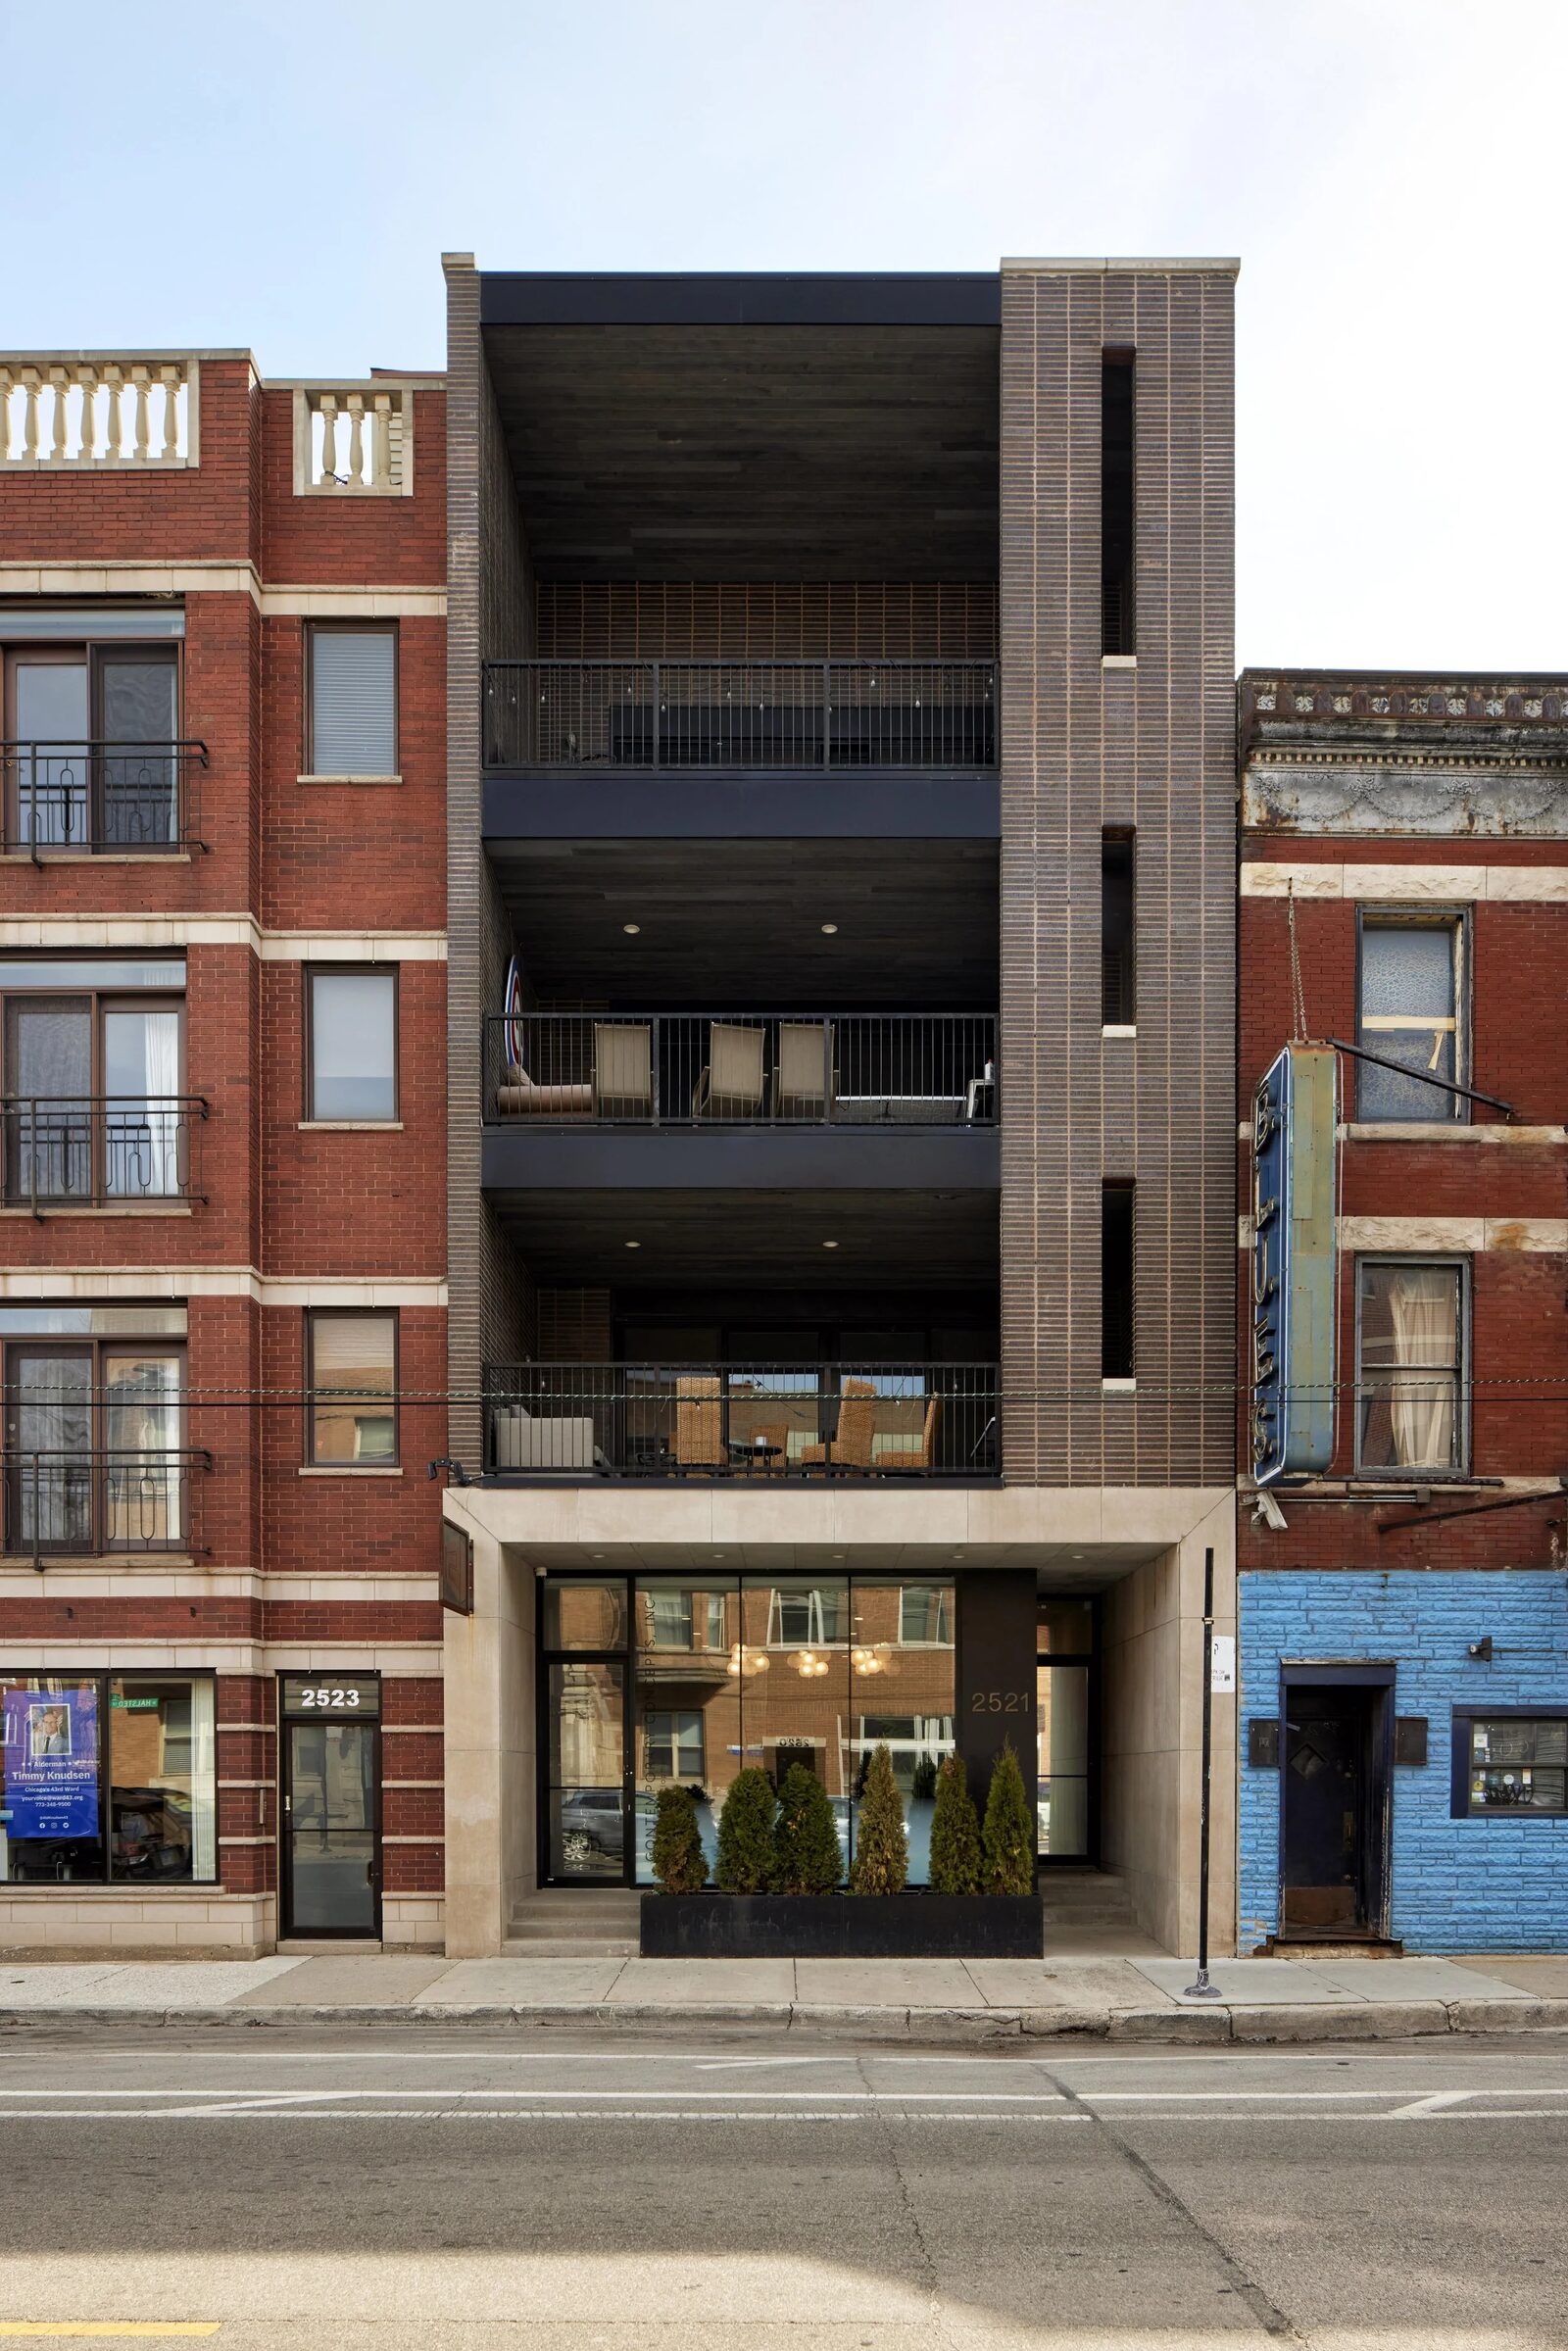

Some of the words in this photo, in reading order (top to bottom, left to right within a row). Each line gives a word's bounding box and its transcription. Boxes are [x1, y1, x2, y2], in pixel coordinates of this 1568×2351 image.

[644, 1599, 656, 1627] INC
[301, 1689, 360, 1707] 2523
[971, 1692, 1029, 1712] 2521
[12, 1771, 45, 1782] Timmy
[47, 1771, 90, 1780] Knudsen
